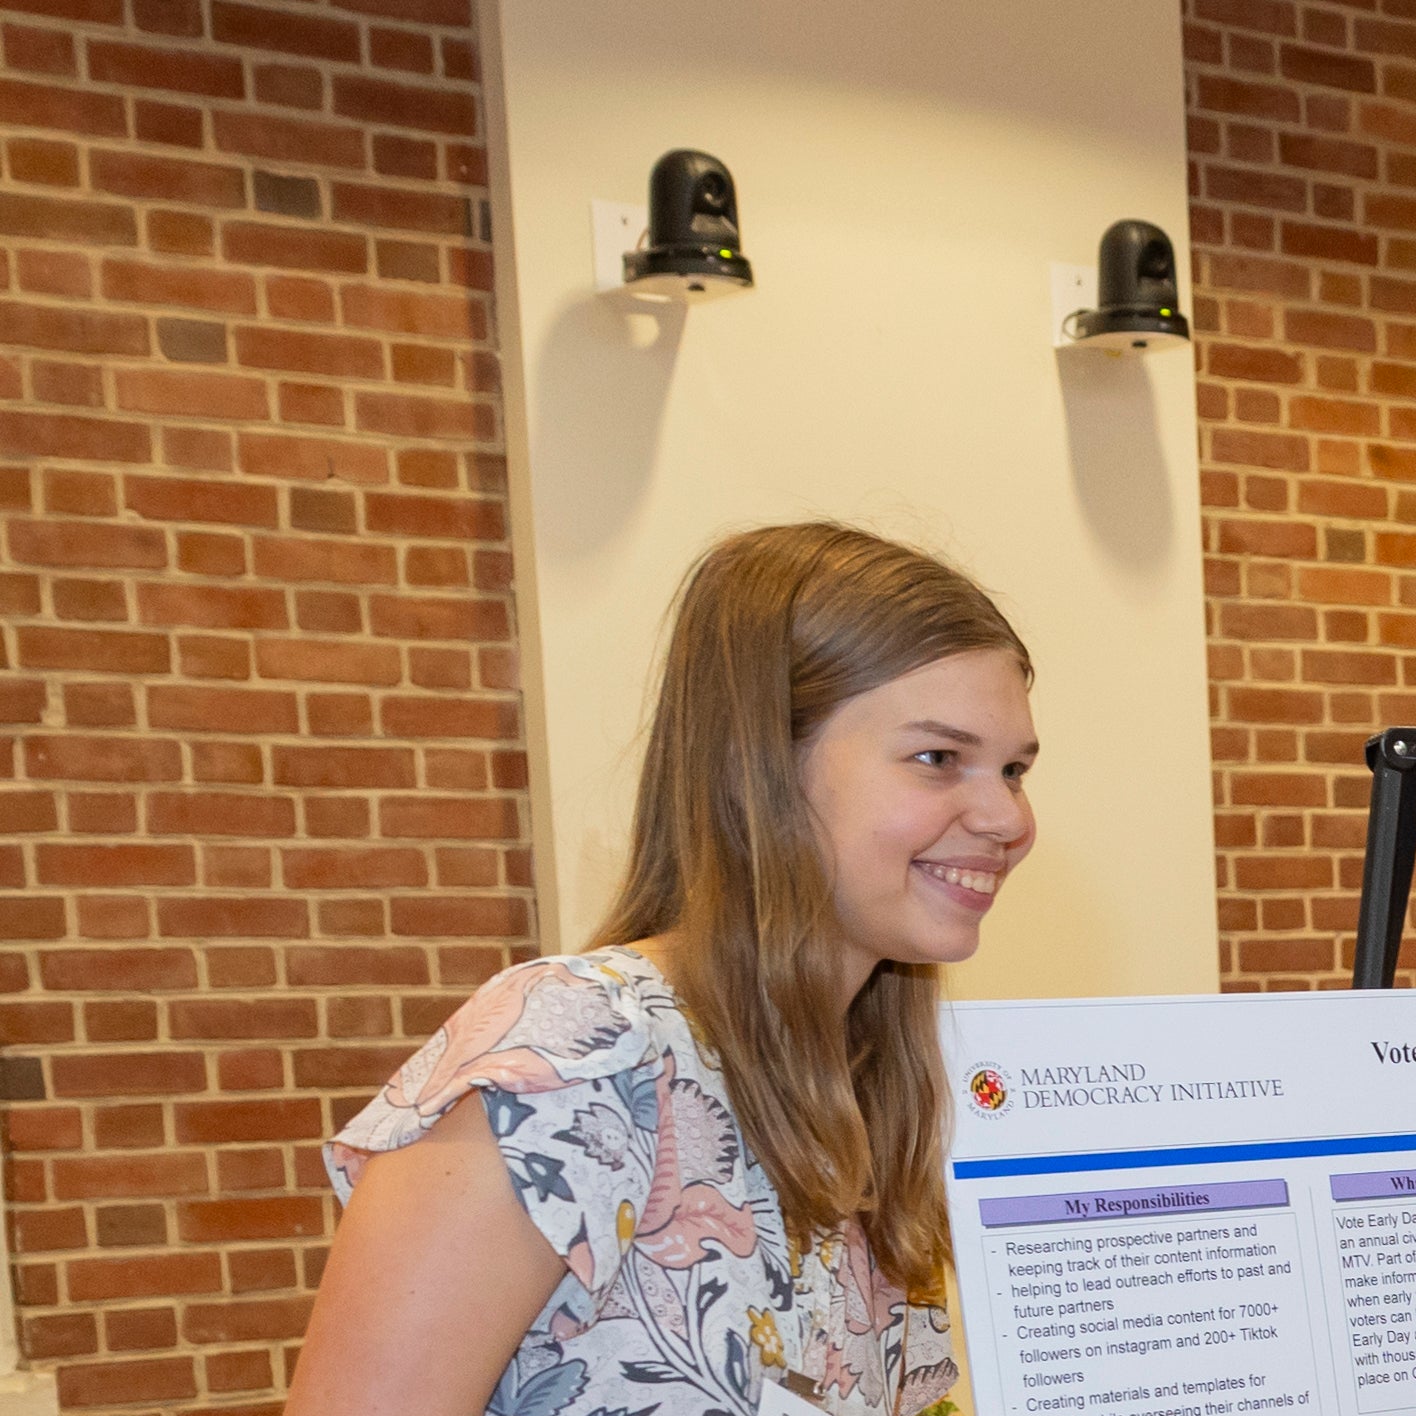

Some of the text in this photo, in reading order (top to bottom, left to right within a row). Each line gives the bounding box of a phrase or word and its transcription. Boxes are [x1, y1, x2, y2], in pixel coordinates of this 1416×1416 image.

[1020, 1063, 1146, 1086] MARYLAND
[1022, 1079, 1284, 1109] DEMOCRACY INITIATIVE
[967, 1099, 1015, 1121] MARYLAND
[1063, 1191, 1210, 1218] My Responsibilities
[1335, 1216, 1365, 1230] Vote
[1367, 1213, 1398, 1229] Early
[1005, 1223, 1258, 1256] Researching prospective partners and
[1007, 1242, 1277, 1278] keeping track of their content information
[1016, 1302, 1279, 1340] Creating social media content for 7000+
[1019, 1325, 1279, 1364] followers on instagram and 200+ Tiktok
[1351, 1331, 1383, 1348] Early
[1386, 1329, 1411, 1345] Day
[1025, 1373, 1266, 1412] Creating materials and templates for
[1357, 1372, 1391, 1389] place
[1392, 1370, 1409, 1382] on
